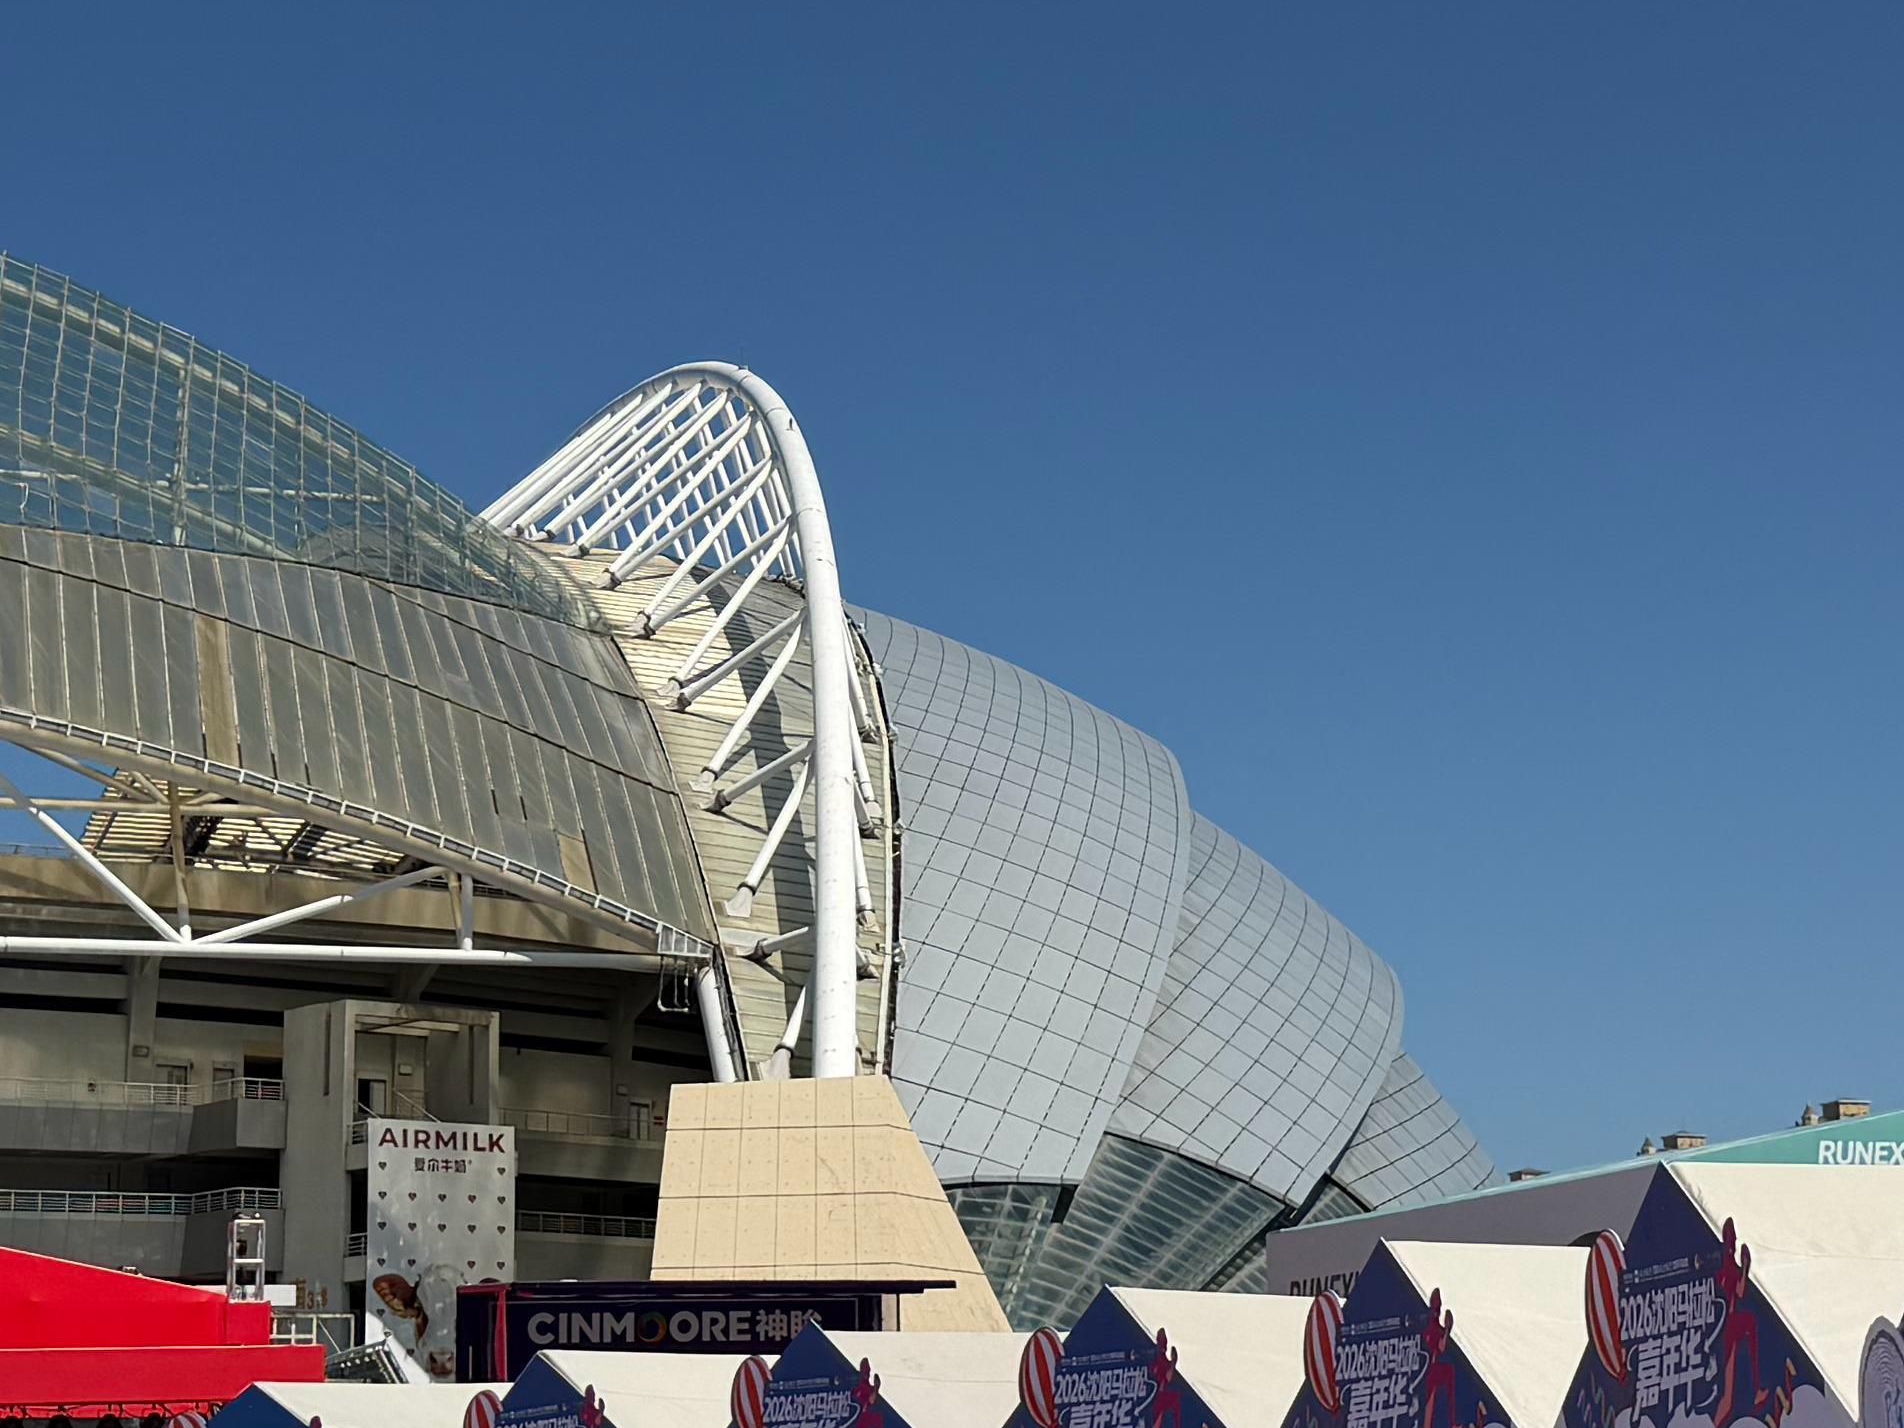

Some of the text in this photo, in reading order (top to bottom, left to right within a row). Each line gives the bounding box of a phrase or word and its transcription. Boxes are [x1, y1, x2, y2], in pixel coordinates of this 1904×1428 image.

[378, 1127, 505, 1154] AIRMILK
[527, 1311, 752, 1344] CINMOORE
[1619, 1277, 1715, 1342] 2026沈阳马拉松
[1335, 1334, 1423, 1382] 2026沈阳马拉松
[1632, 1328, 1705, 1422] 嘉年华
[1054, 1366, 1148, 1406] 2026沈阳马拉松
[763, 1390, 852, 1423] 2026沈阳马拉松
